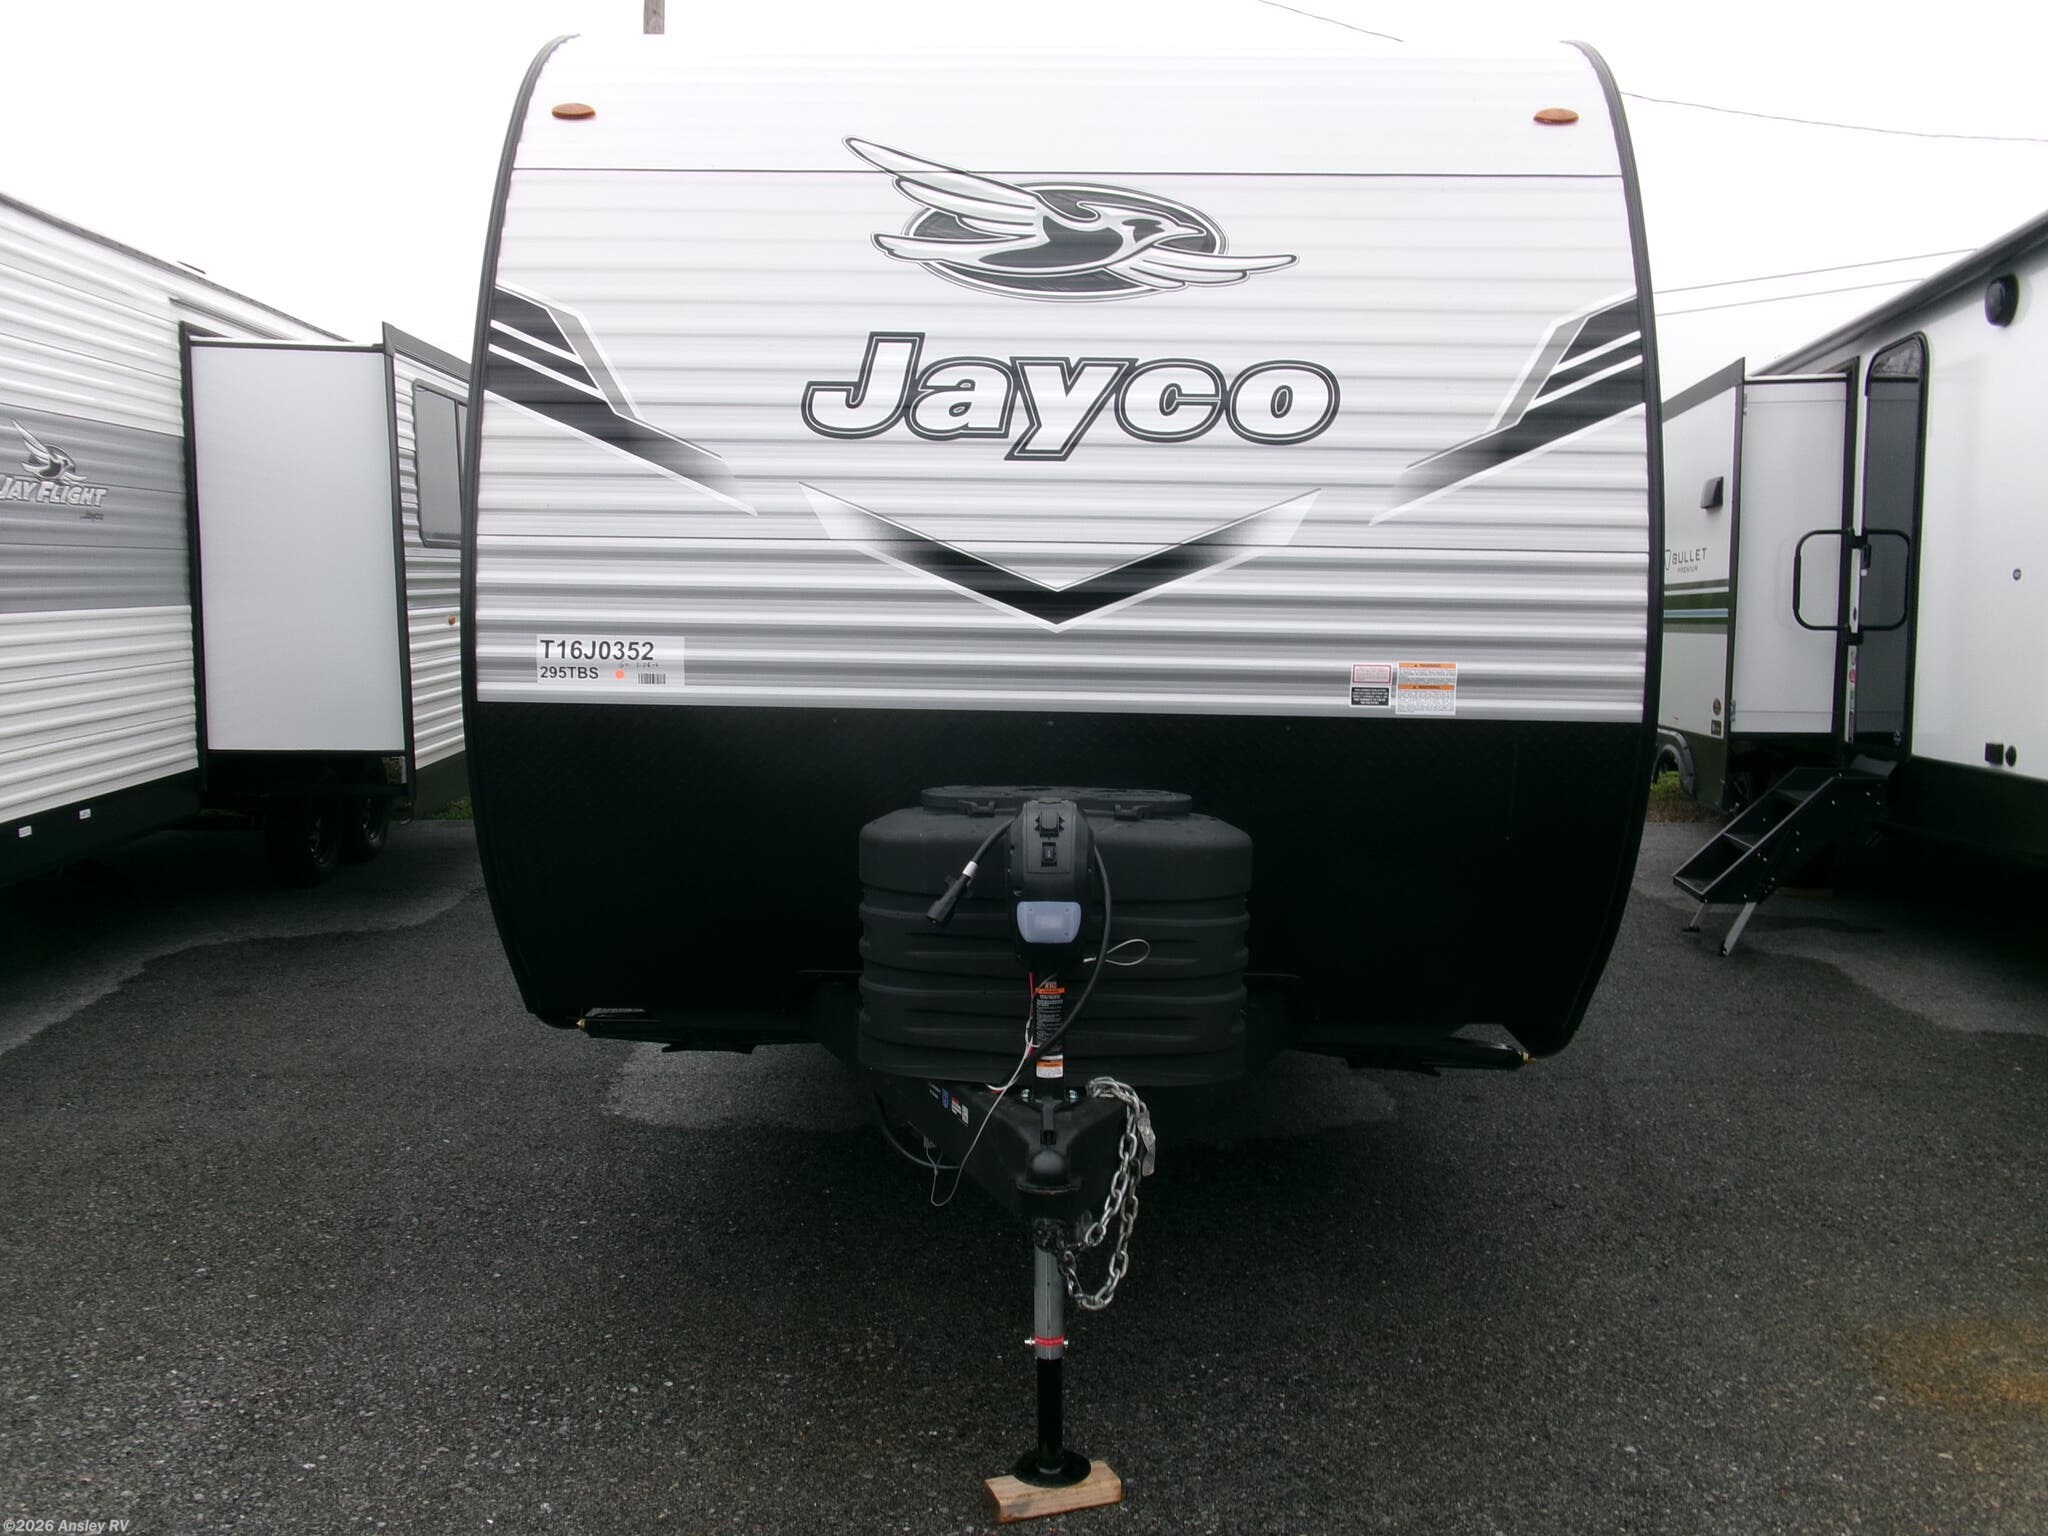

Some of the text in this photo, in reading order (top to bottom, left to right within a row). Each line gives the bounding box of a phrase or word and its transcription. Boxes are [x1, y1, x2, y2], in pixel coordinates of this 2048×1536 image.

[801, 331, 1341, 461] Jayco
[0, 477, 108, 507] JAY FLIGHT
[1672, 547, 1707, 565] BULLET
[540, 640, 654, 660] T16J0352
[540, 666, 599, 679] 295TBS
